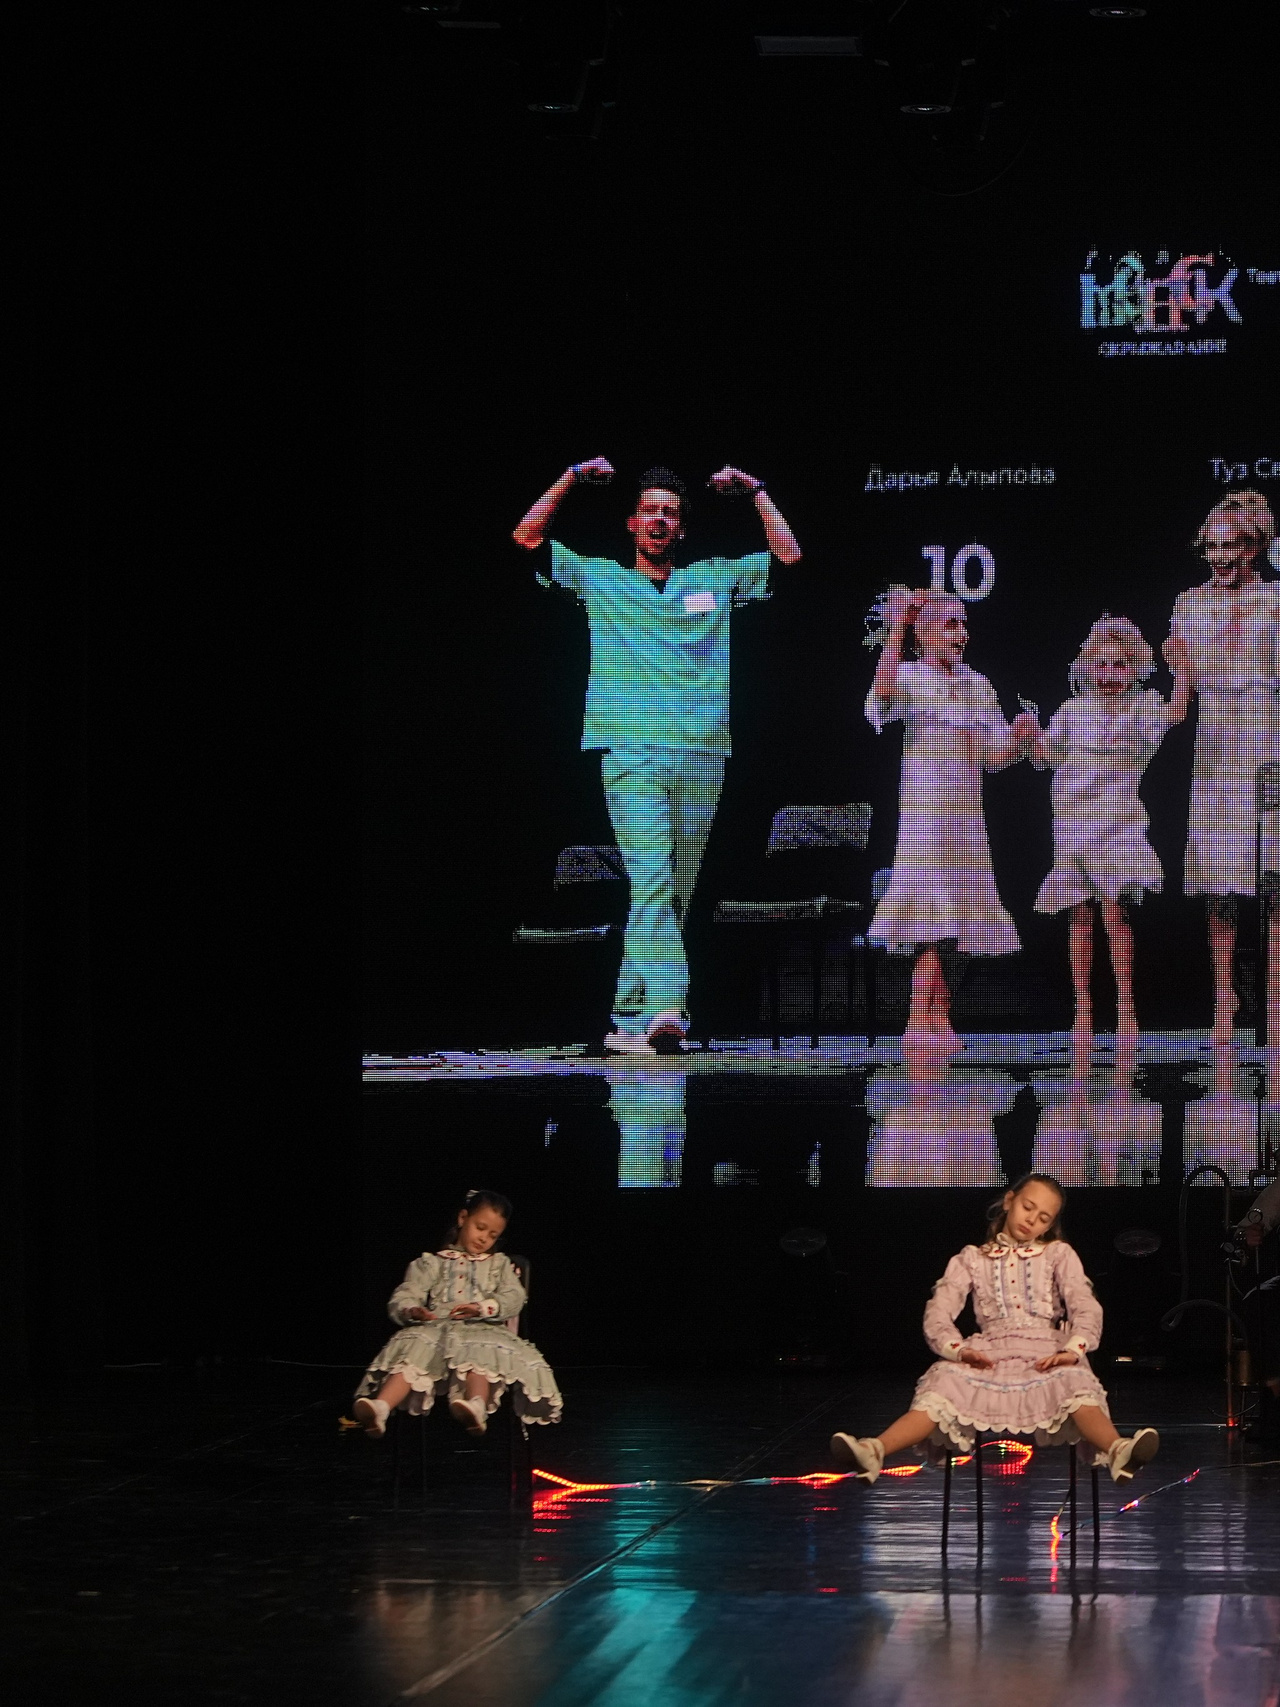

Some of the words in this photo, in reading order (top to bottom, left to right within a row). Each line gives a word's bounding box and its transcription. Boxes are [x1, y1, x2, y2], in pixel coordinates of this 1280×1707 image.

[864, 463, 940, 493] Дарья
[1208, 457, 1249, 484] Туз
[921, 544, 996, 602] 10
